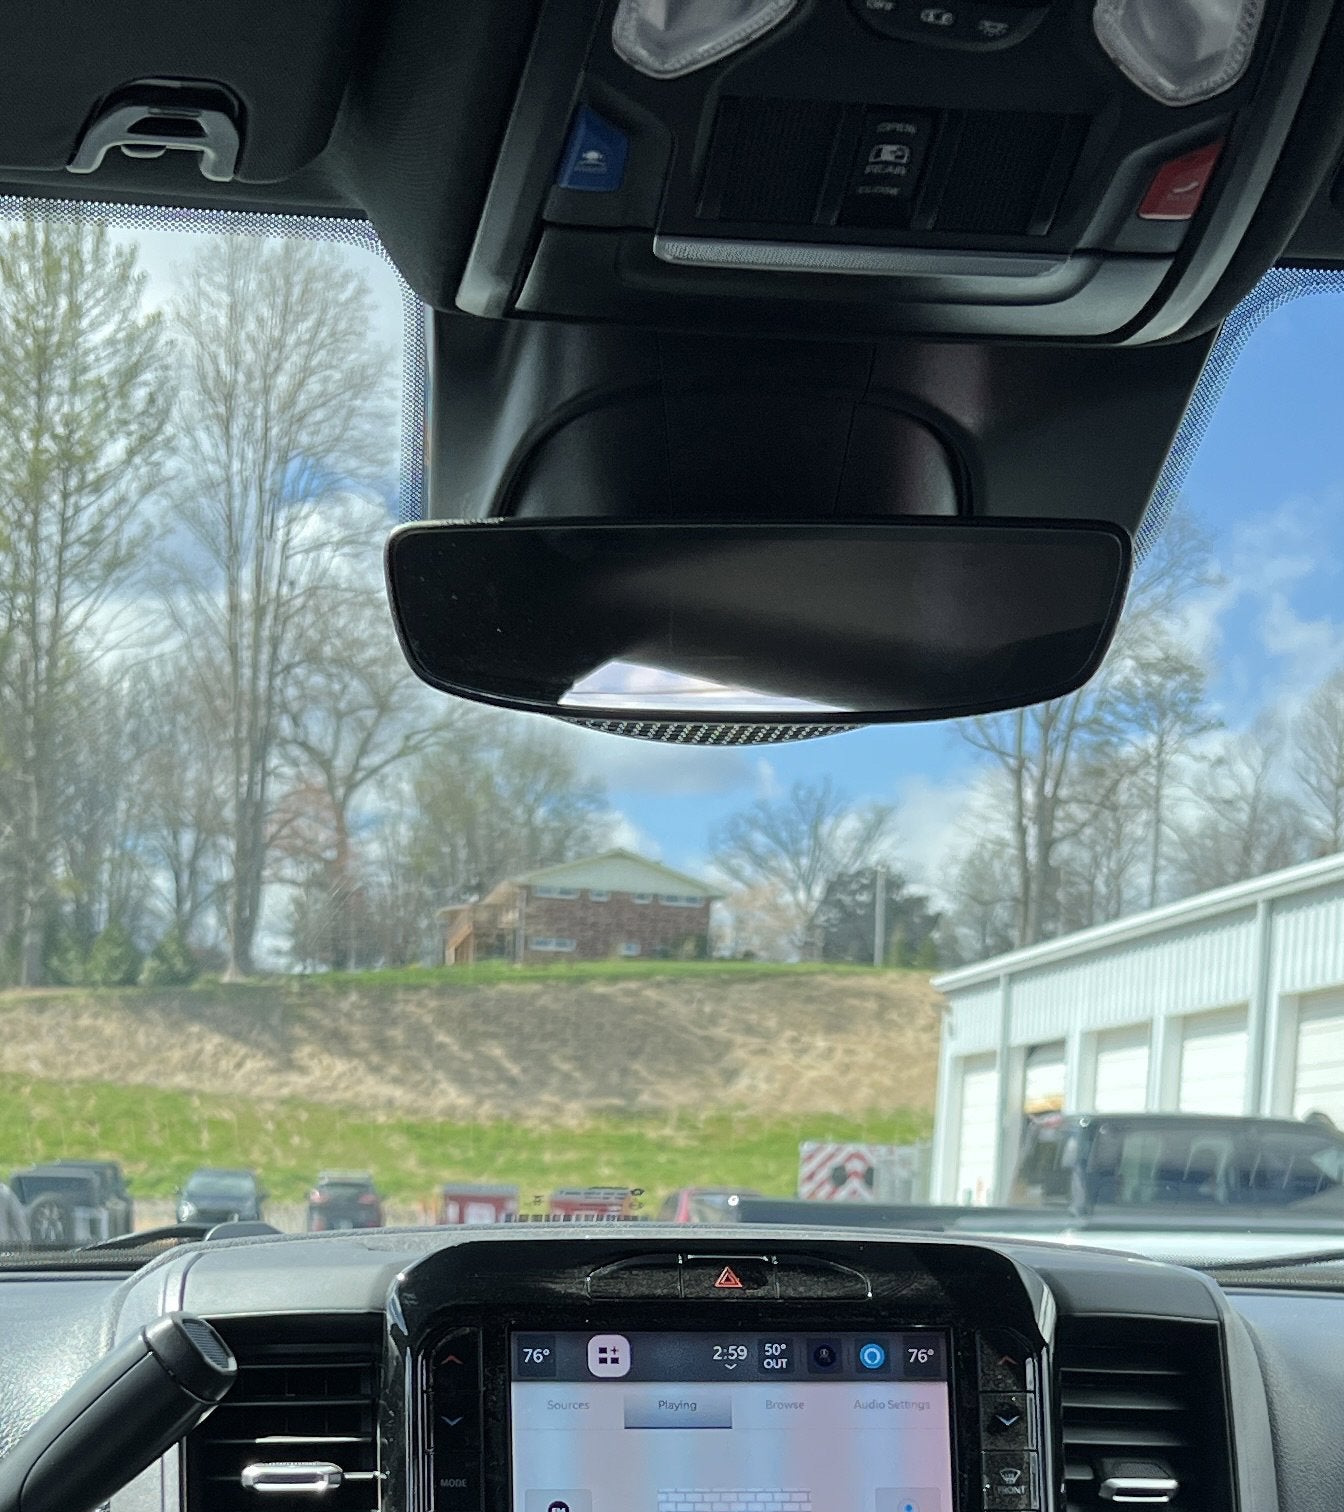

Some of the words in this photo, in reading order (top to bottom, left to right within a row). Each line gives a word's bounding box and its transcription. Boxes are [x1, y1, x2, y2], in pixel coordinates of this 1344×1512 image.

[712, 1345, 748, 1360] 2:59
[763, 1358, 788, 1369] OUT
[546, 1399, 590, 1411] Sources
[657, 1398, 697, 1413] Playing
[765, 1399, 805, 1410] Browse
[853, 1399, 886, 1410] Audio
[887, 1399, 931, 1412] Settings
[440, 1478, 468, 1488] MODE
